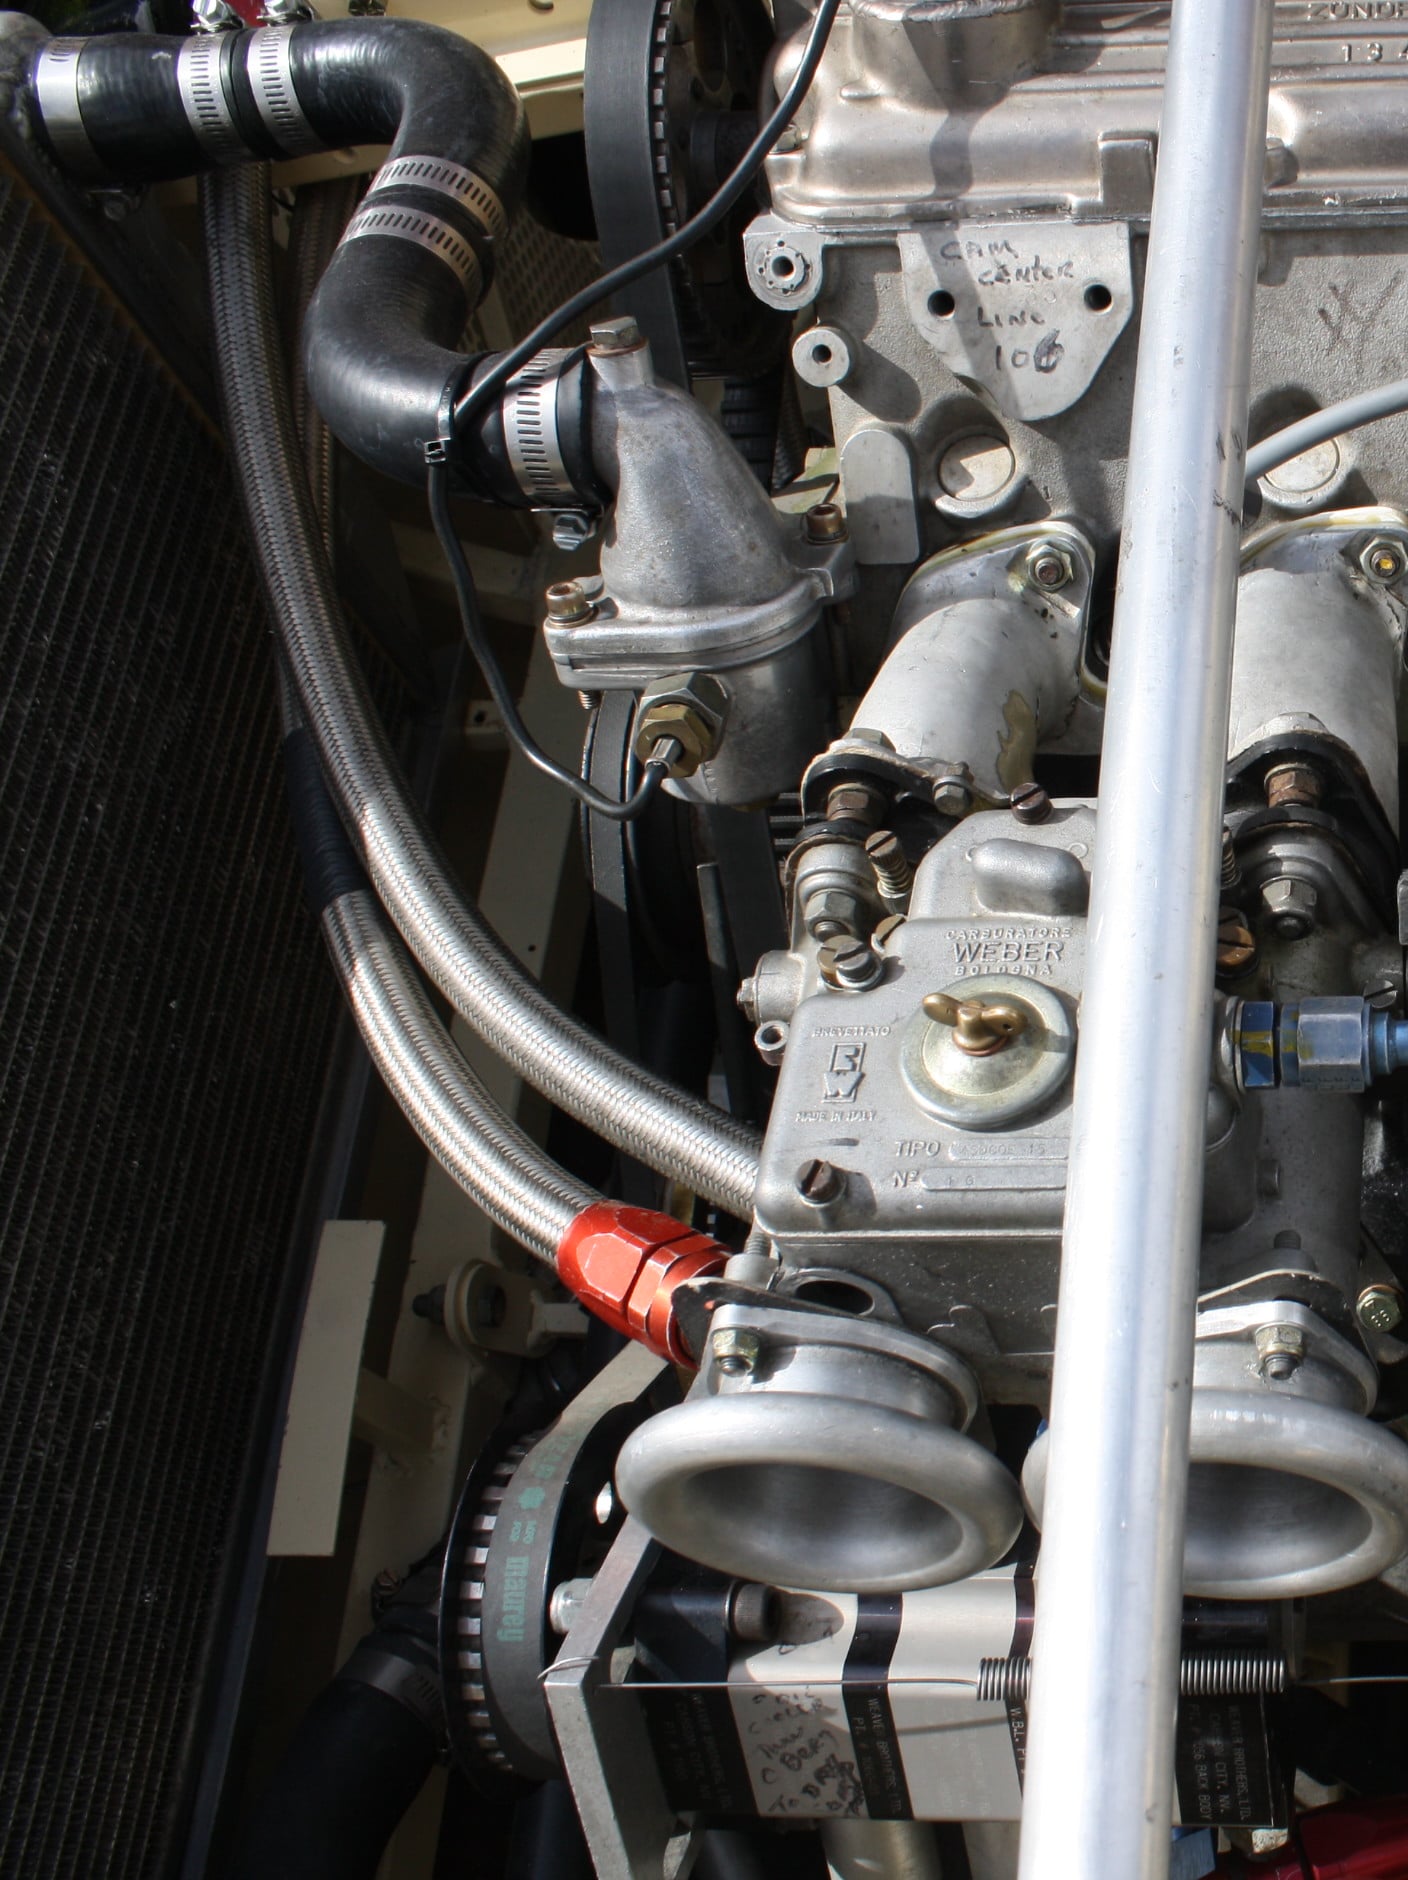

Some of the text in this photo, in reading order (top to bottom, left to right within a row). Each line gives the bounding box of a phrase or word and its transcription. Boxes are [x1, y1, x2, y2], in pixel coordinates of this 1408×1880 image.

[945, 927, 1073, 940] CARBURATORE
[952, 941, 1064, 963] WEBER
[954, 964, 1053, 976] BOLOGNA
[894, 1140, 942, 1157] TIPO
